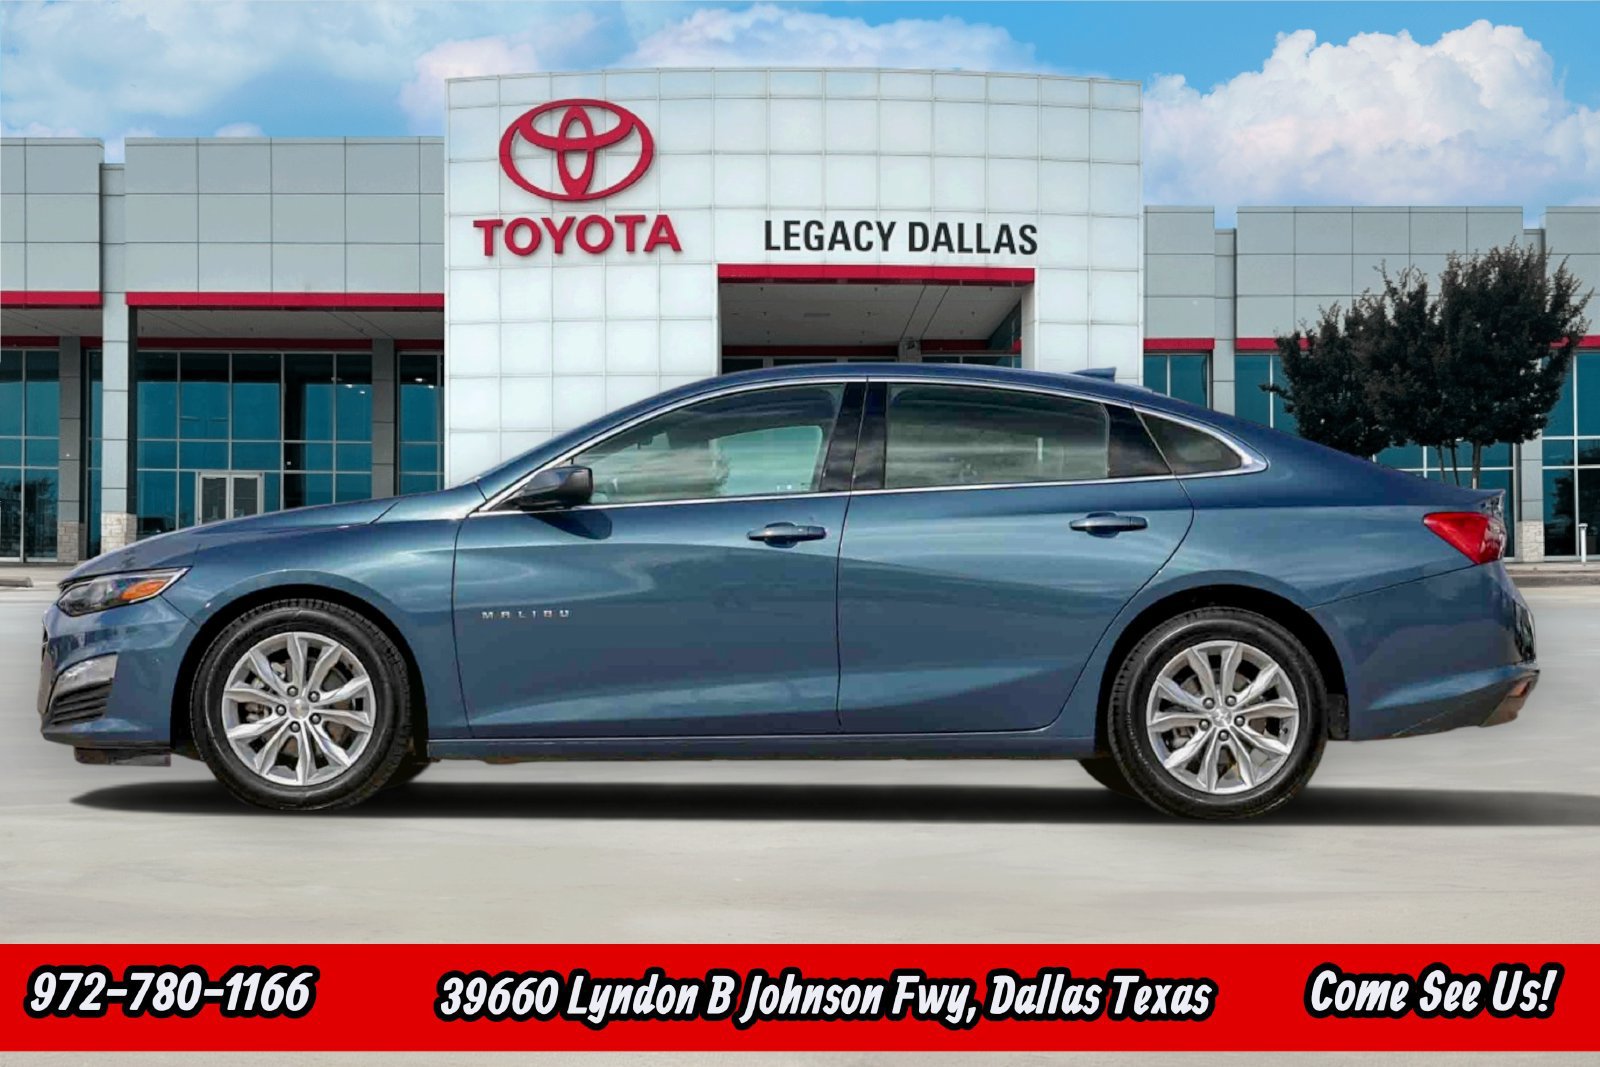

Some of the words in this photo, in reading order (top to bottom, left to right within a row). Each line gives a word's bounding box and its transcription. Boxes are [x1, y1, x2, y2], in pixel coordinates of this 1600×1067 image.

[474, 214, 682, 257] TOYOTA
[764, 220, 897, 252] LEGACY
[908, 221, 1038, 256] DALLAS
[481, 609, 570, 619] MALIBU
